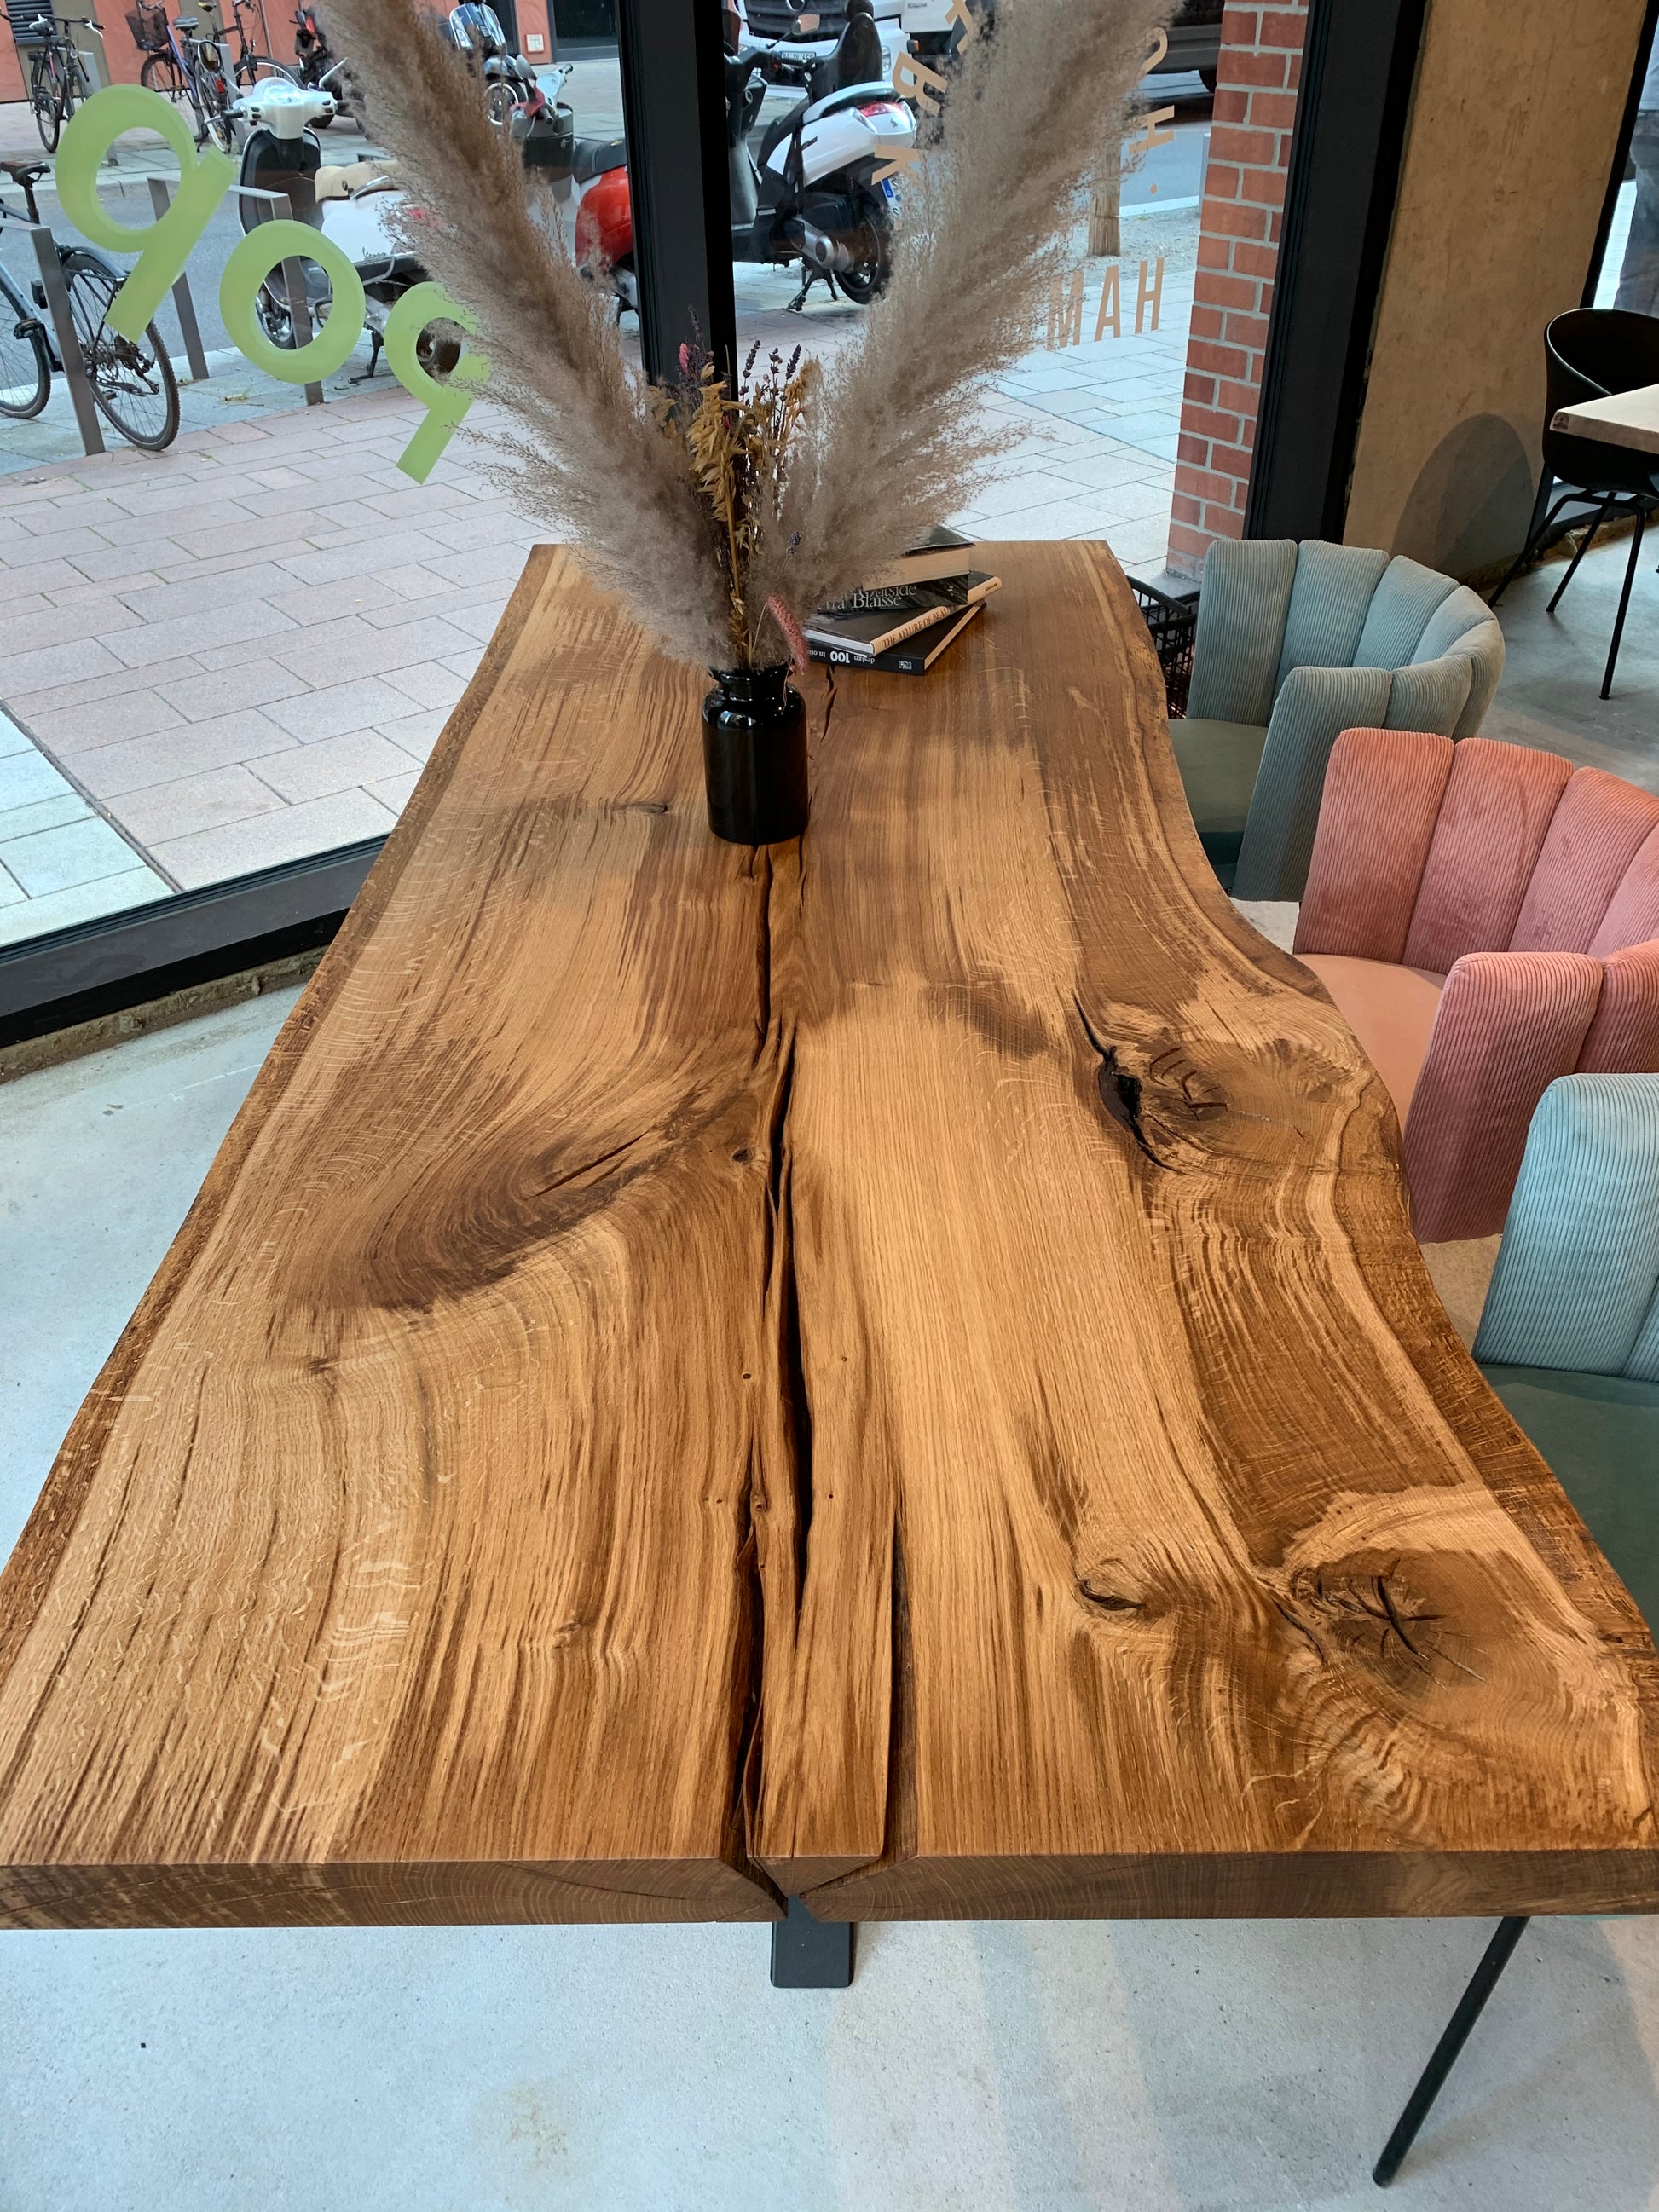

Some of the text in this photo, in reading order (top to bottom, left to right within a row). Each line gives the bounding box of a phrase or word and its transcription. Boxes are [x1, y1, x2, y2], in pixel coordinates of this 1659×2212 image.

[851, 592, 903, 609] Blaisse
[882, 636, 897, 649] THE
[898, 622, 923, 640] ALLURE
[922, 615, 931, 627] OF
[830, 650, 851, 664] 100
[853, 656, 876, 665] design
